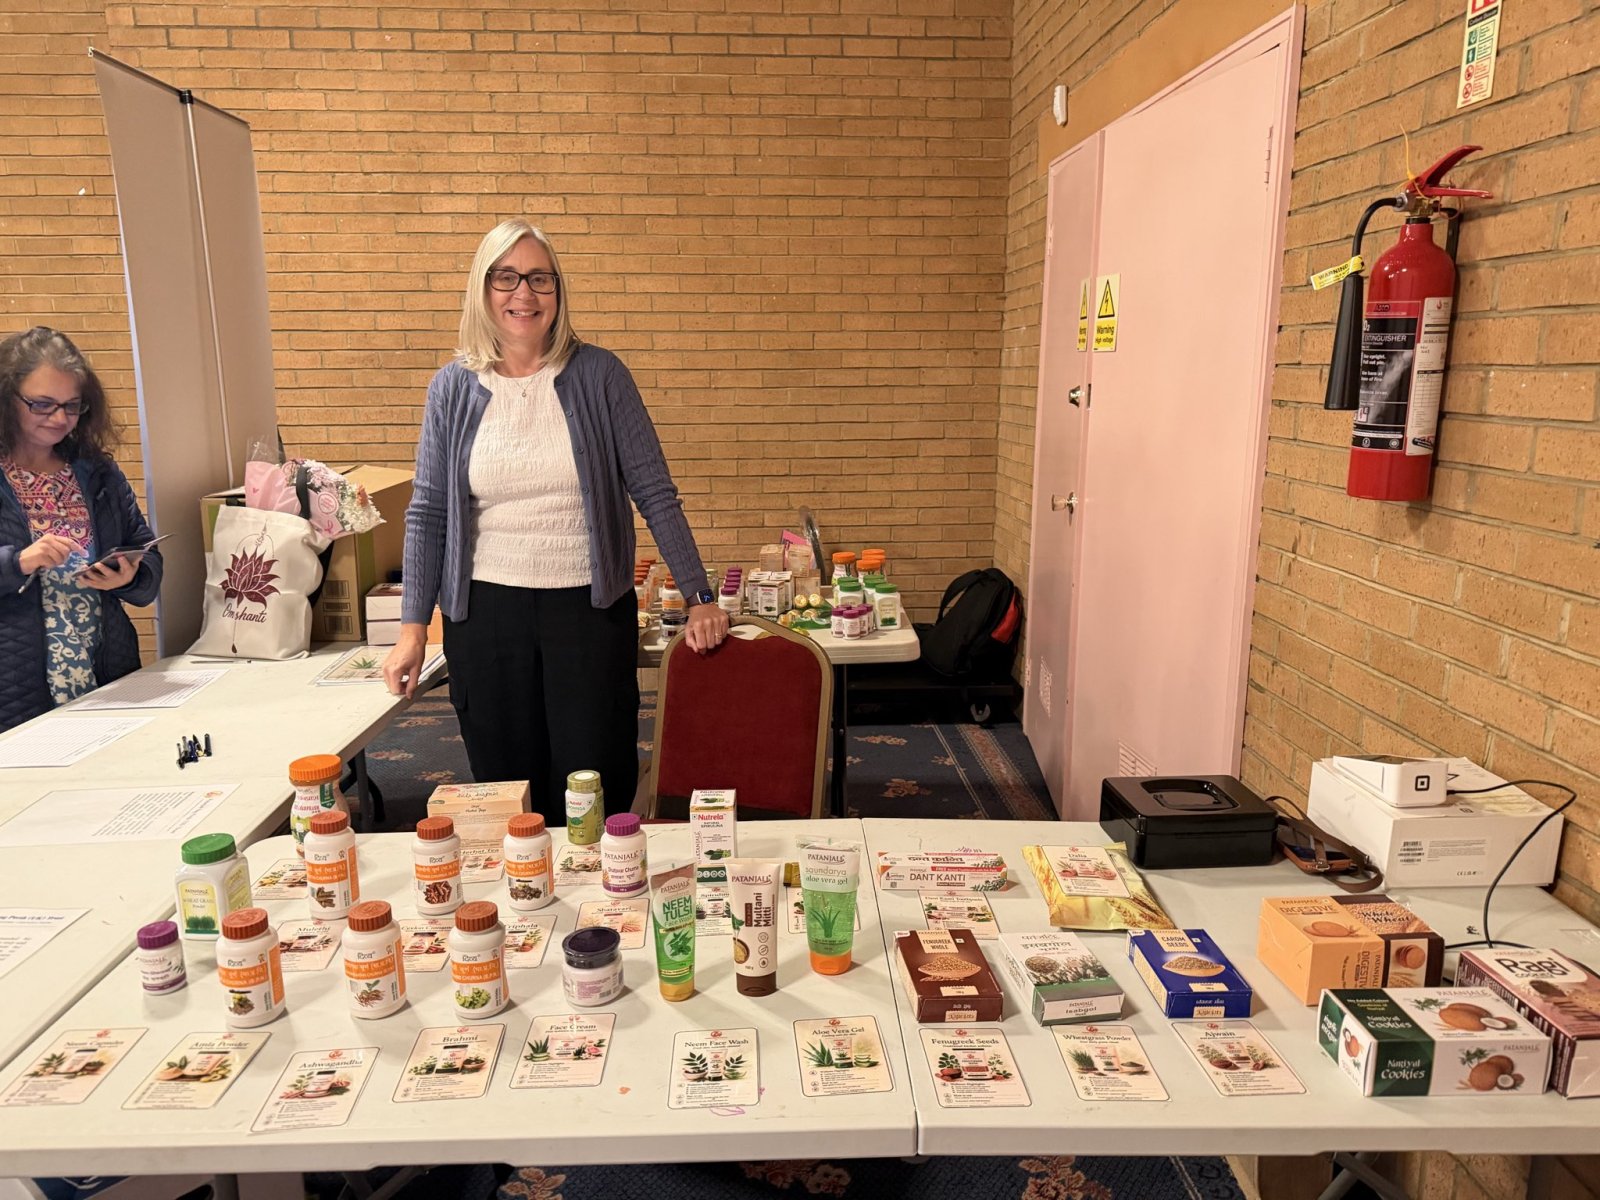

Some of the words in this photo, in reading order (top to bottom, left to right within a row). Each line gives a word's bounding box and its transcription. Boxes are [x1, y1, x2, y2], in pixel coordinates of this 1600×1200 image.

[805, 866, 847, 877] saundarya
[909, 873, 935, 881] DANT
[936, 873, 966, 881] KANTI
[732, 875, 772, 883] PATANJALI
[663, 895, 692, 914] NEEM
[754, 893, 763, 927] Multani
[1280, 905, 1335, 913] DIGESTIVE
[663, 906, 693, 921] TULSI
[763, 907, 772, 927] Mitti
[1359, 951, 1370, 988] DIGESTIV
[1494, 957, 1570, 976] Ragi
[1367, 1021, 1412, 1029] Cookies
[298, 1060, 363, 1069] Ashwagandha
[1387, 1059, 1420, 1068] Nariyal
[1381, 1069, 1425, 1080] Cookies
